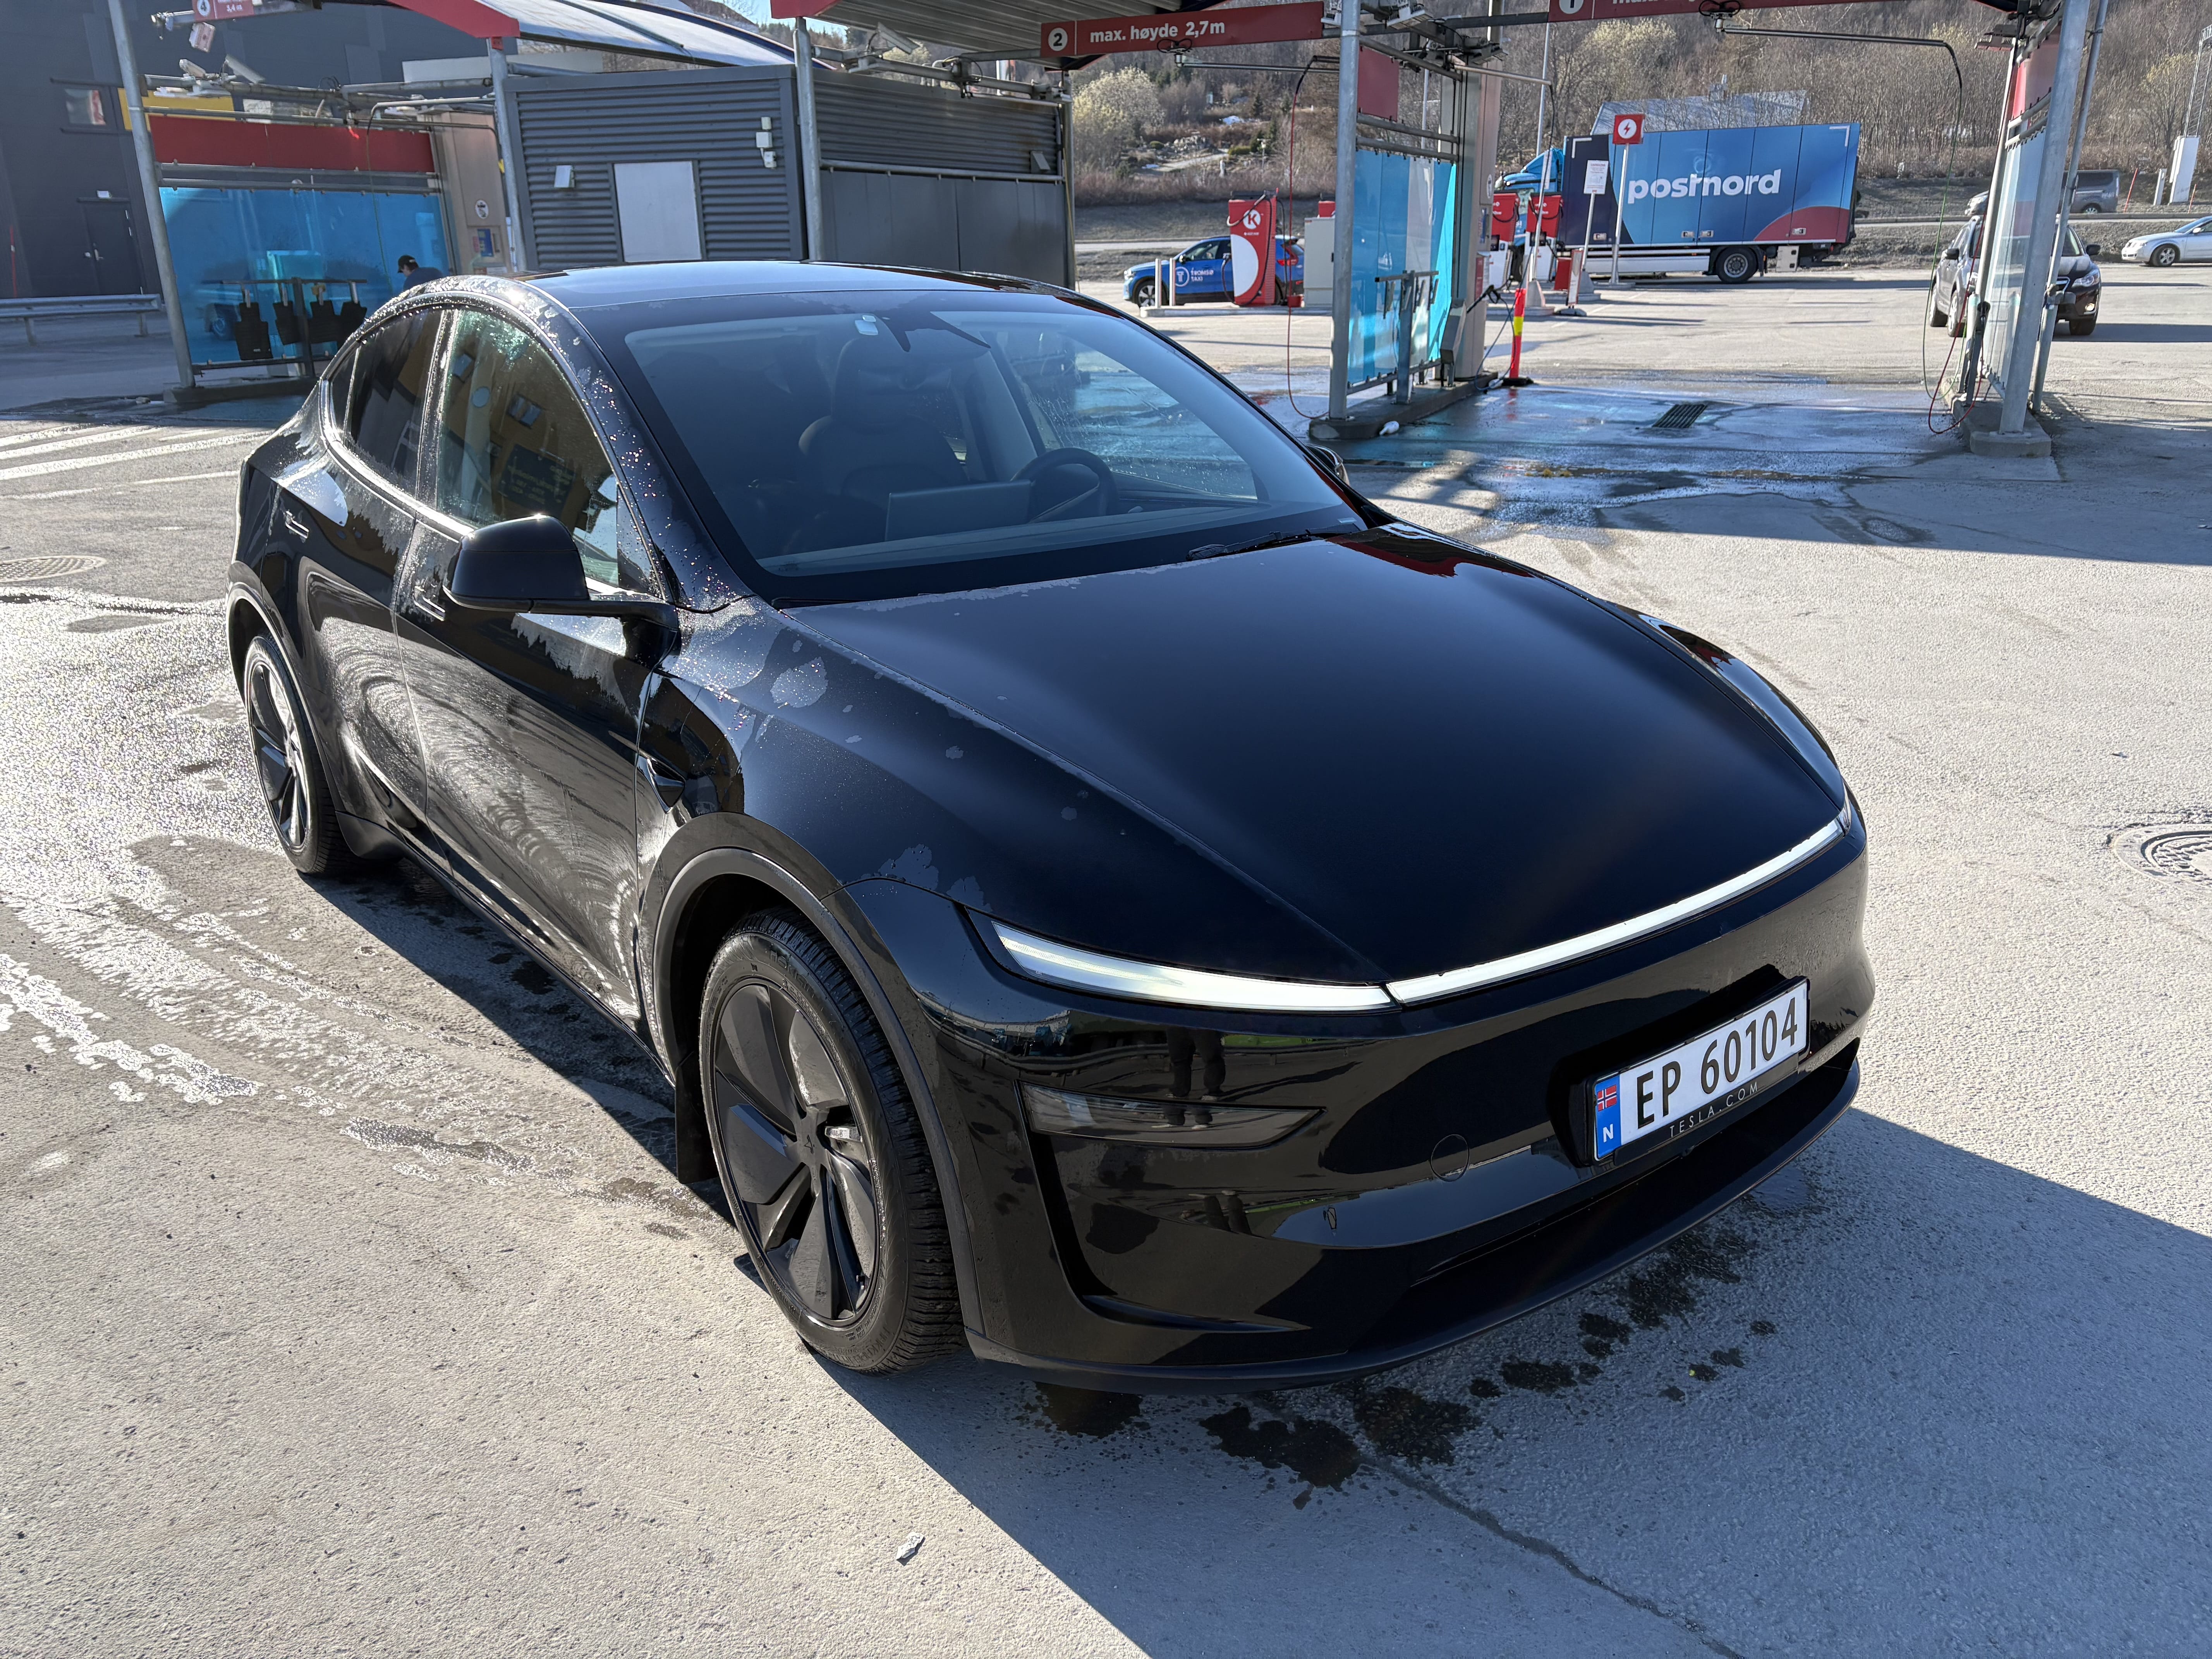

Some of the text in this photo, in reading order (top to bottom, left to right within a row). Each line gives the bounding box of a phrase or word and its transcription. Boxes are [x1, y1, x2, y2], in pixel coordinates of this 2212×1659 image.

[1053, 33, 1063, 46] 2
[1090, 30, 1126, 43] max.
[1130, 23, 1178, 41] høyde
[1628, 168, 1781, 204] postnord
[1637, 997, 1798, 1129] EP 60104
[1669, 1081, 1757, 1137] TESLA.COM
[1602, 1123, 1614, 1143] N
